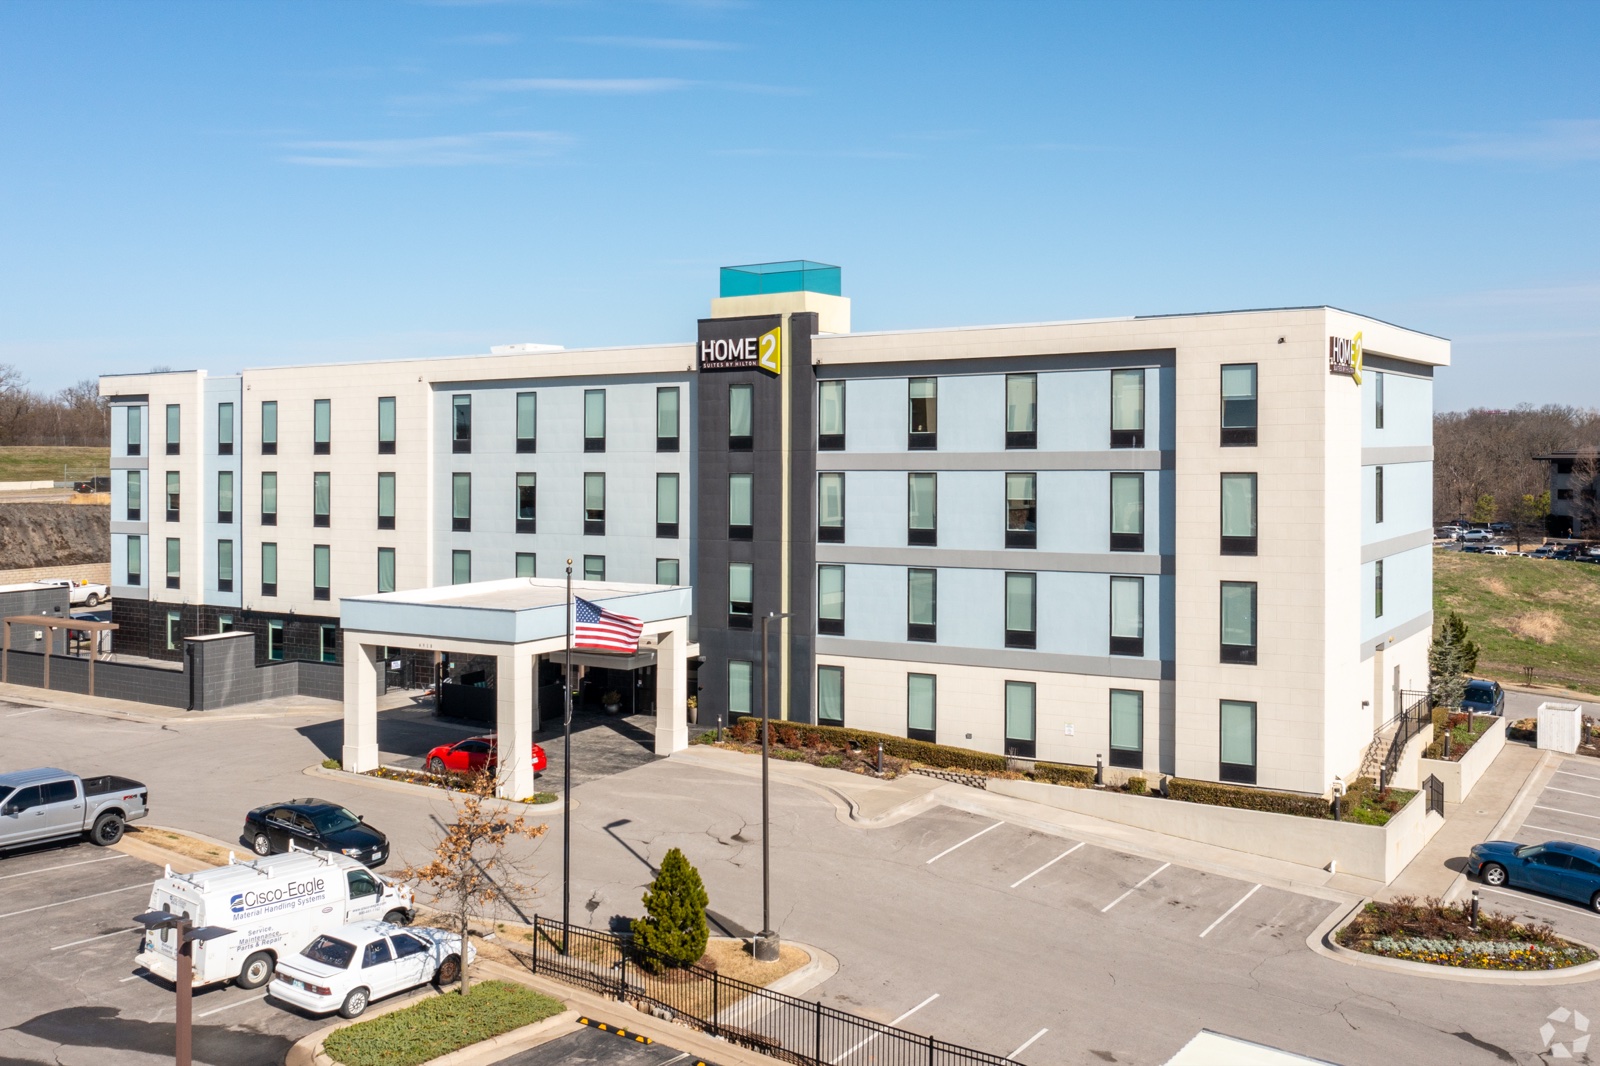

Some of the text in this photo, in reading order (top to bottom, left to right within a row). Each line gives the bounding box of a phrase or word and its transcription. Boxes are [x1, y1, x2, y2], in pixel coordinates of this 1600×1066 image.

[701, 334, 776, 369] HOME 2
[1334, 337, 1355, 365] HOME
[233, 893, 326, 921] Material Handling Systems
[236, 943, 254, 952] Parts
[261, 936, 283, 946] Repair
